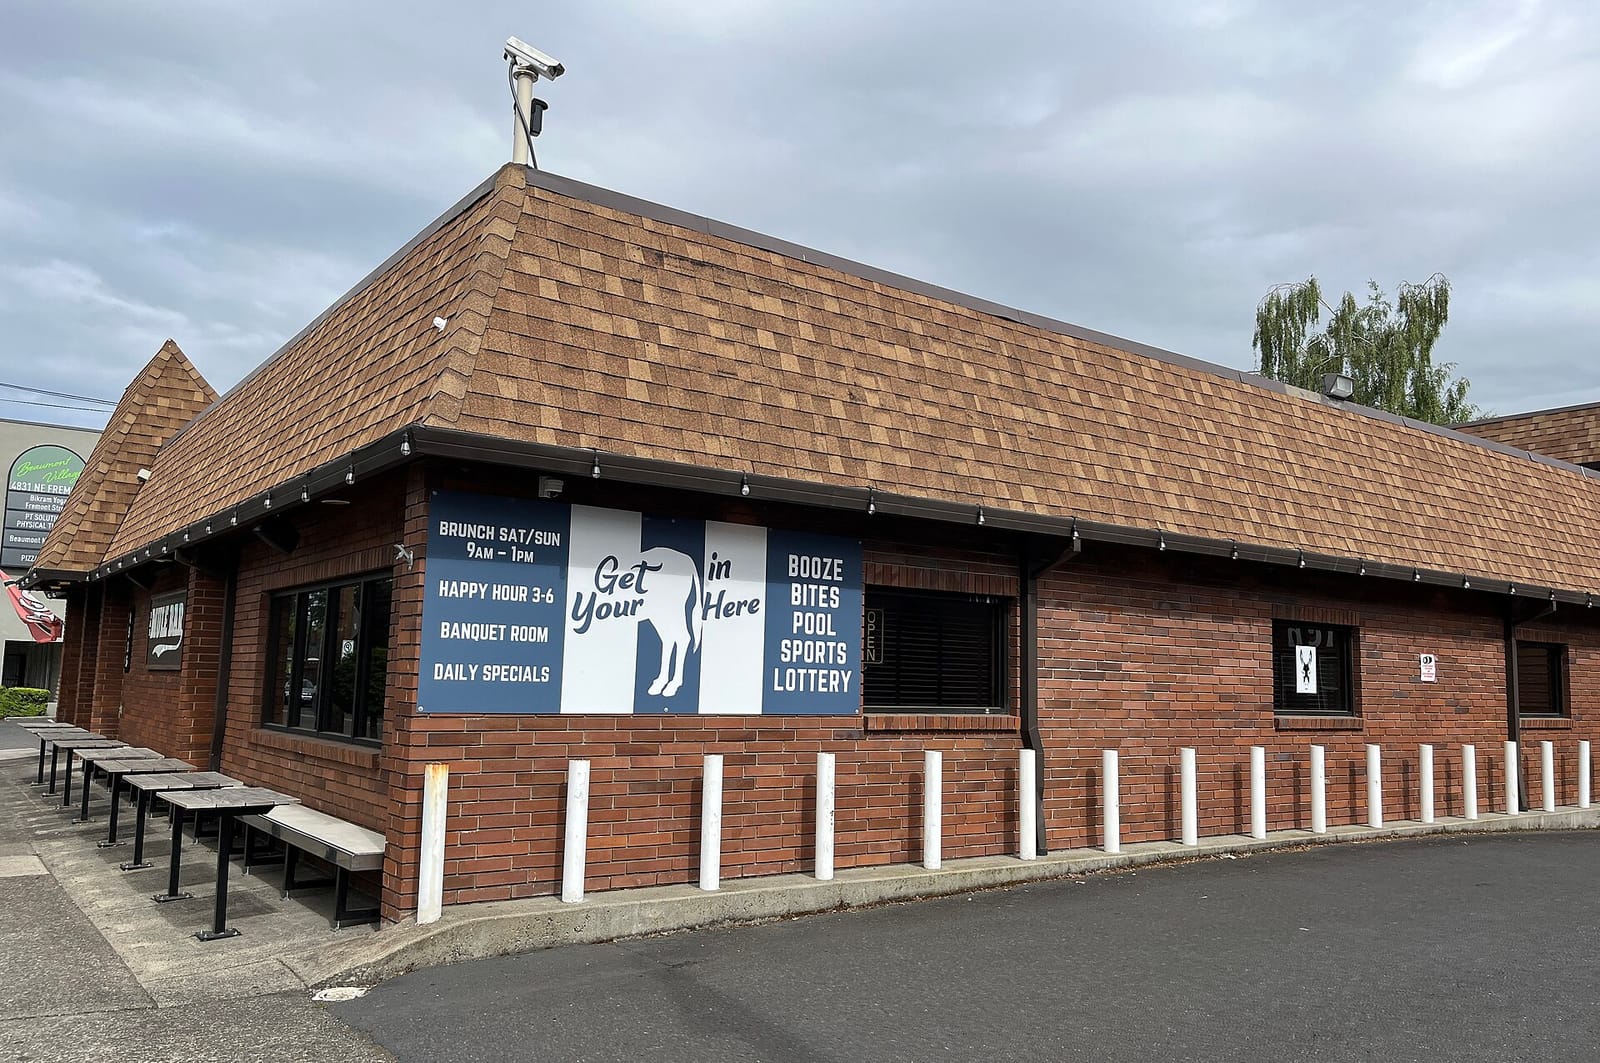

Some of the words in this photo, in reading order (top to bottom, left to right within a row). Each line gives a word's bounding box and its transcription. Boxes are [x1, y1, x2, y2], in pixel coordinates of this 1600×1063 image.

[16, 455, 72, 477] Beaumont
[11, 481, 31, 491] 4831
[34, 482, 46, 492] NE
[16, 520, 46, 529] PHYSICAL
[439, 521, 495, 540] BRUNCH
[499, 528, 560, 546] SAT/SUN
[466, 542, 493, 560] 9AM
[511, 545, 534, 563] 1PM
[594, 555, 663, 596] Get
[708, 551, 731, 581] in
[788, 554, 844, 581] BOOZE
[439, 579, 488, 600] HAPPY
[492, 584, 528, 602] HOUR
[532, 587, 554, 604] 3-6
[791, 582, 840, 609] BITES
[571, 591, 644, 635] Your
[701, 589, 760, 621] Here
[440, 622, 506, 642] BANQUET
[510, 626, 548, 643] ROOM
[792, 611, 837, 637] POOL
[867, 611, 876, 661] OPEN
[780, 639, 847, 665] SPORTS
[433, 663, 479, 681] DAILY
[482, 664, 550, 683] SPECIALS
[773, 667, 852, 693] LOTTERY
